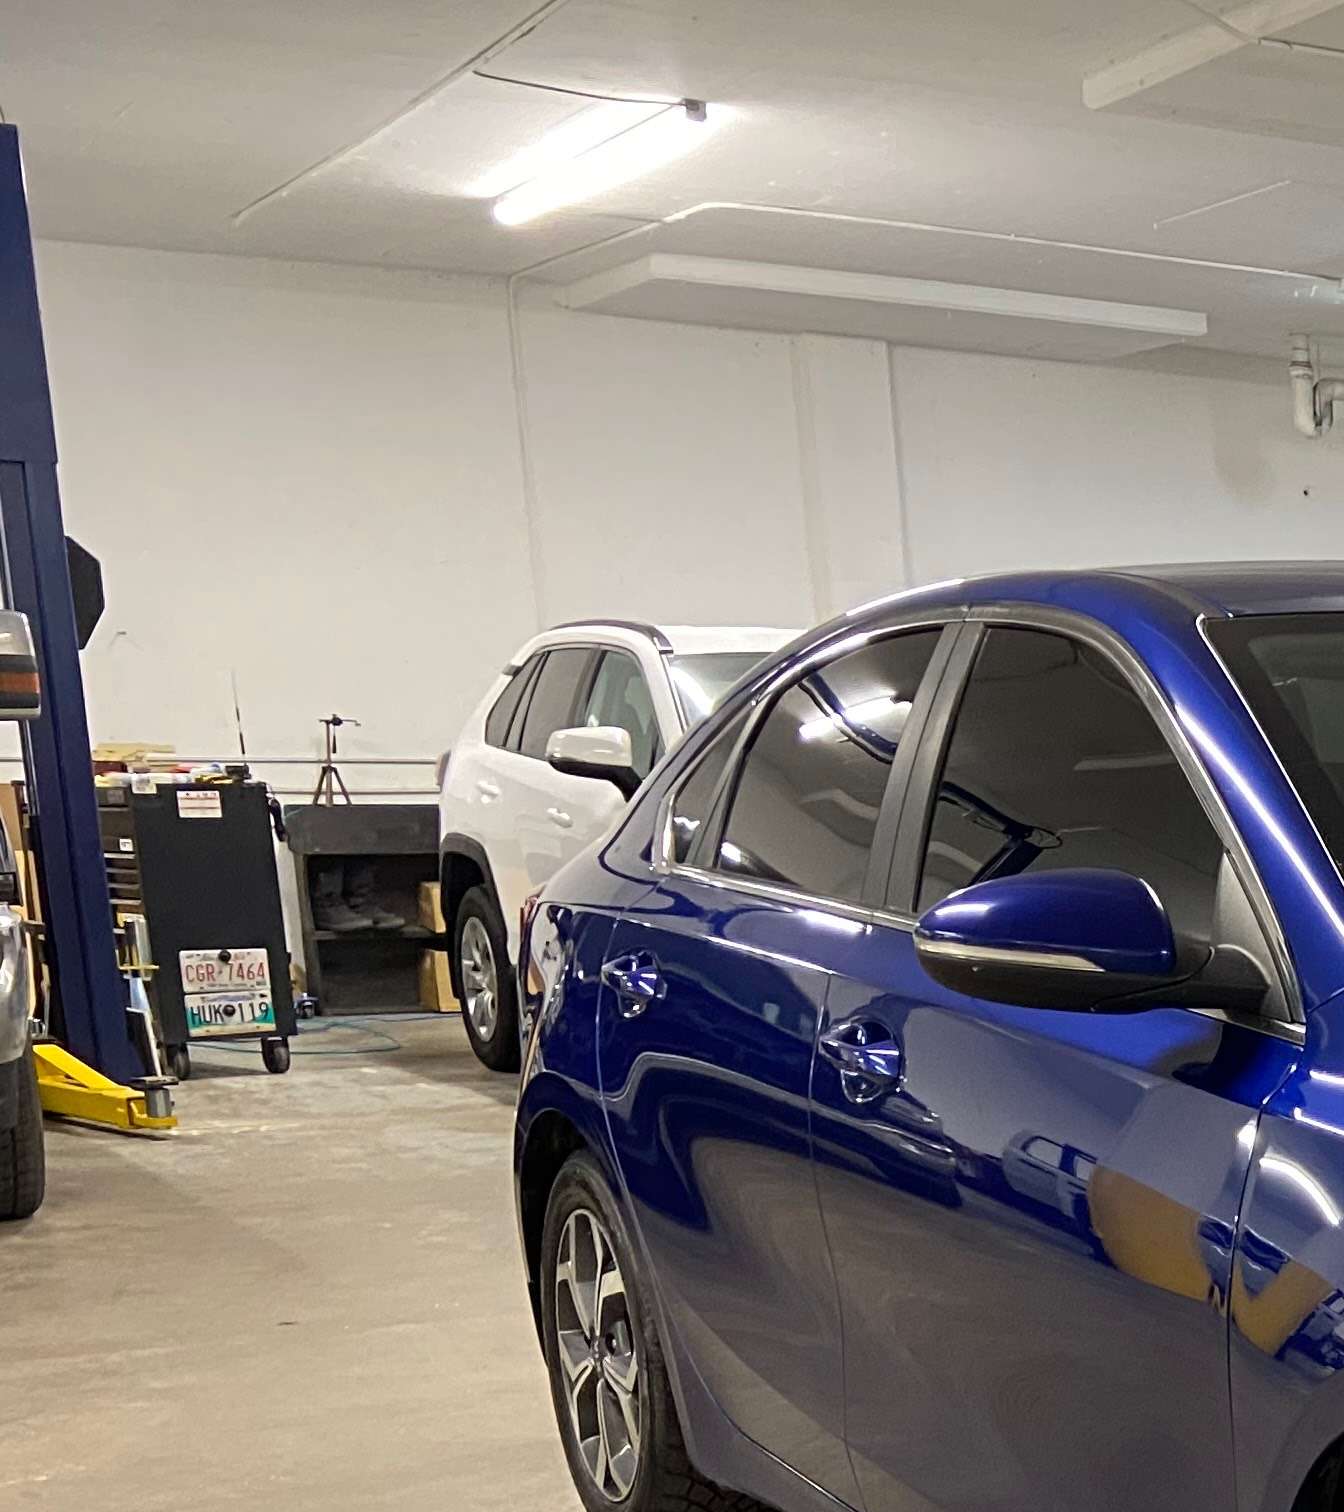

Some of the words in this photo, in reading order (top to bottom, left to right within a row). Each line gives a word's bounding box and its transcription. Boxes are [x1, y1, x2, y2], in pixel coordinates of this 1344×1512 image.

[185, 963, 216, 983] CGR
[225, 962, 265, 981] 7464
[190, 1004, 225, 1026] HUK
[237, 1001, 269, 1022] 119
